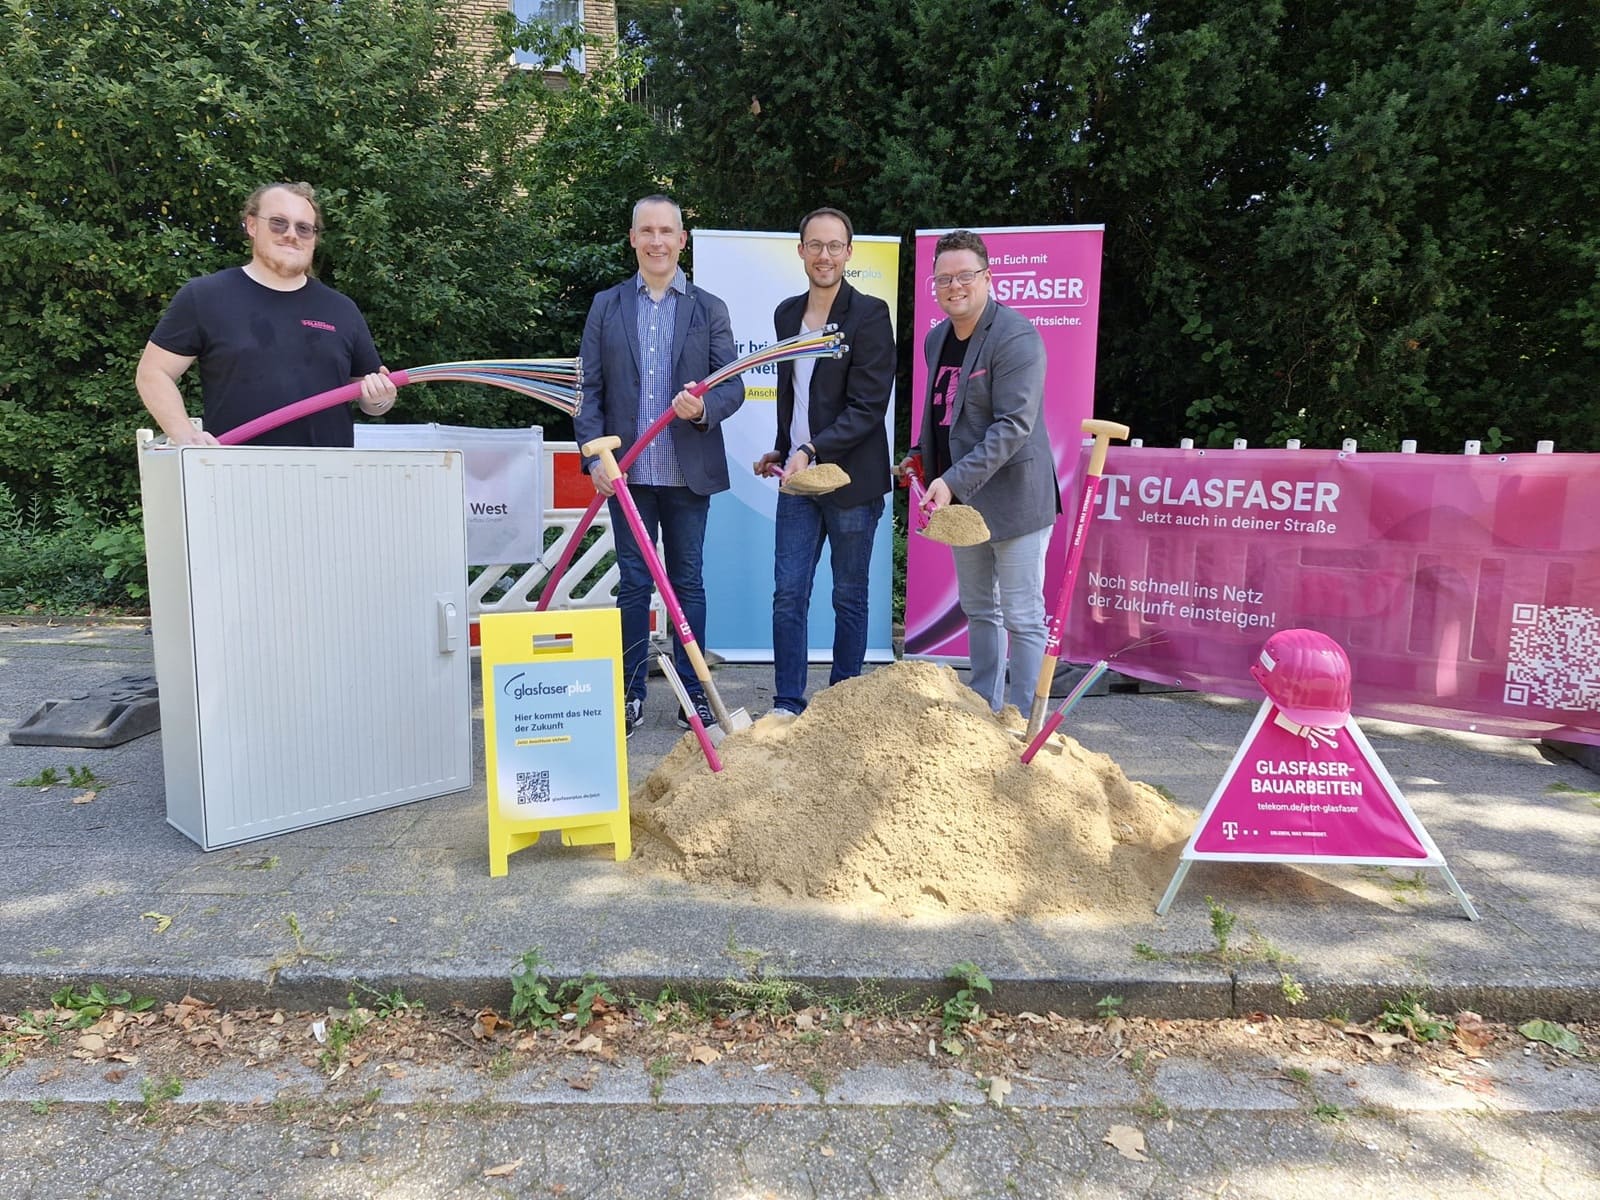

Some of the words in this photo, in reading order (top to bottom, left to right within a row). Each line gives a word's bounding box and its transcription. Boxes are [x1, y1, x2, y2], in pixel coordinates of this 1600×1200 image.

[1004, 254, 1028, 266] Euch
[1030, 253, 1047, 265] mit
[751, 362, 777, 375] Net
[1138, 476, 1341, 513] GLASFASER
[470, 502, 508, 515] West
[1138, 510, 1173, 525] Jetzt
[1175, 512, 1209, 527] auch
[1213, 514, 1228, 527] in
[1231, 515, 1281, 531] deiner
[1284, 518, 1337, 534] Straße
[1088, 572, 1126, 591] Noch
[1130, 577, 1189, 597] schnell
[1194, 582, 1218, 600] ins
[1223, 586, 1264, 605] Netz
[1087, 592, 1112, 608] der
[1114, 594, 1176, 617] Zukunft
[1179, 603, 1276, 629] einsteigen!
[514, 680, 592, 701] glasfaserplus
[514, 713, 532, 722] Hier
[534, 711, 564, 720] kommt
[566, 710, 581, 718] das
[582, 709, 602, 717] Netz
[515, 724, 529, 733] der
[531, 722, 564, 732] Zukunft
[1256, 760, 1356, 777] GLASFASER-
[1251, 779, 1363, 796] BAUARBEITEN
[1257, 802, 1359, 814] telekom.de/jetzt-glasfaser
